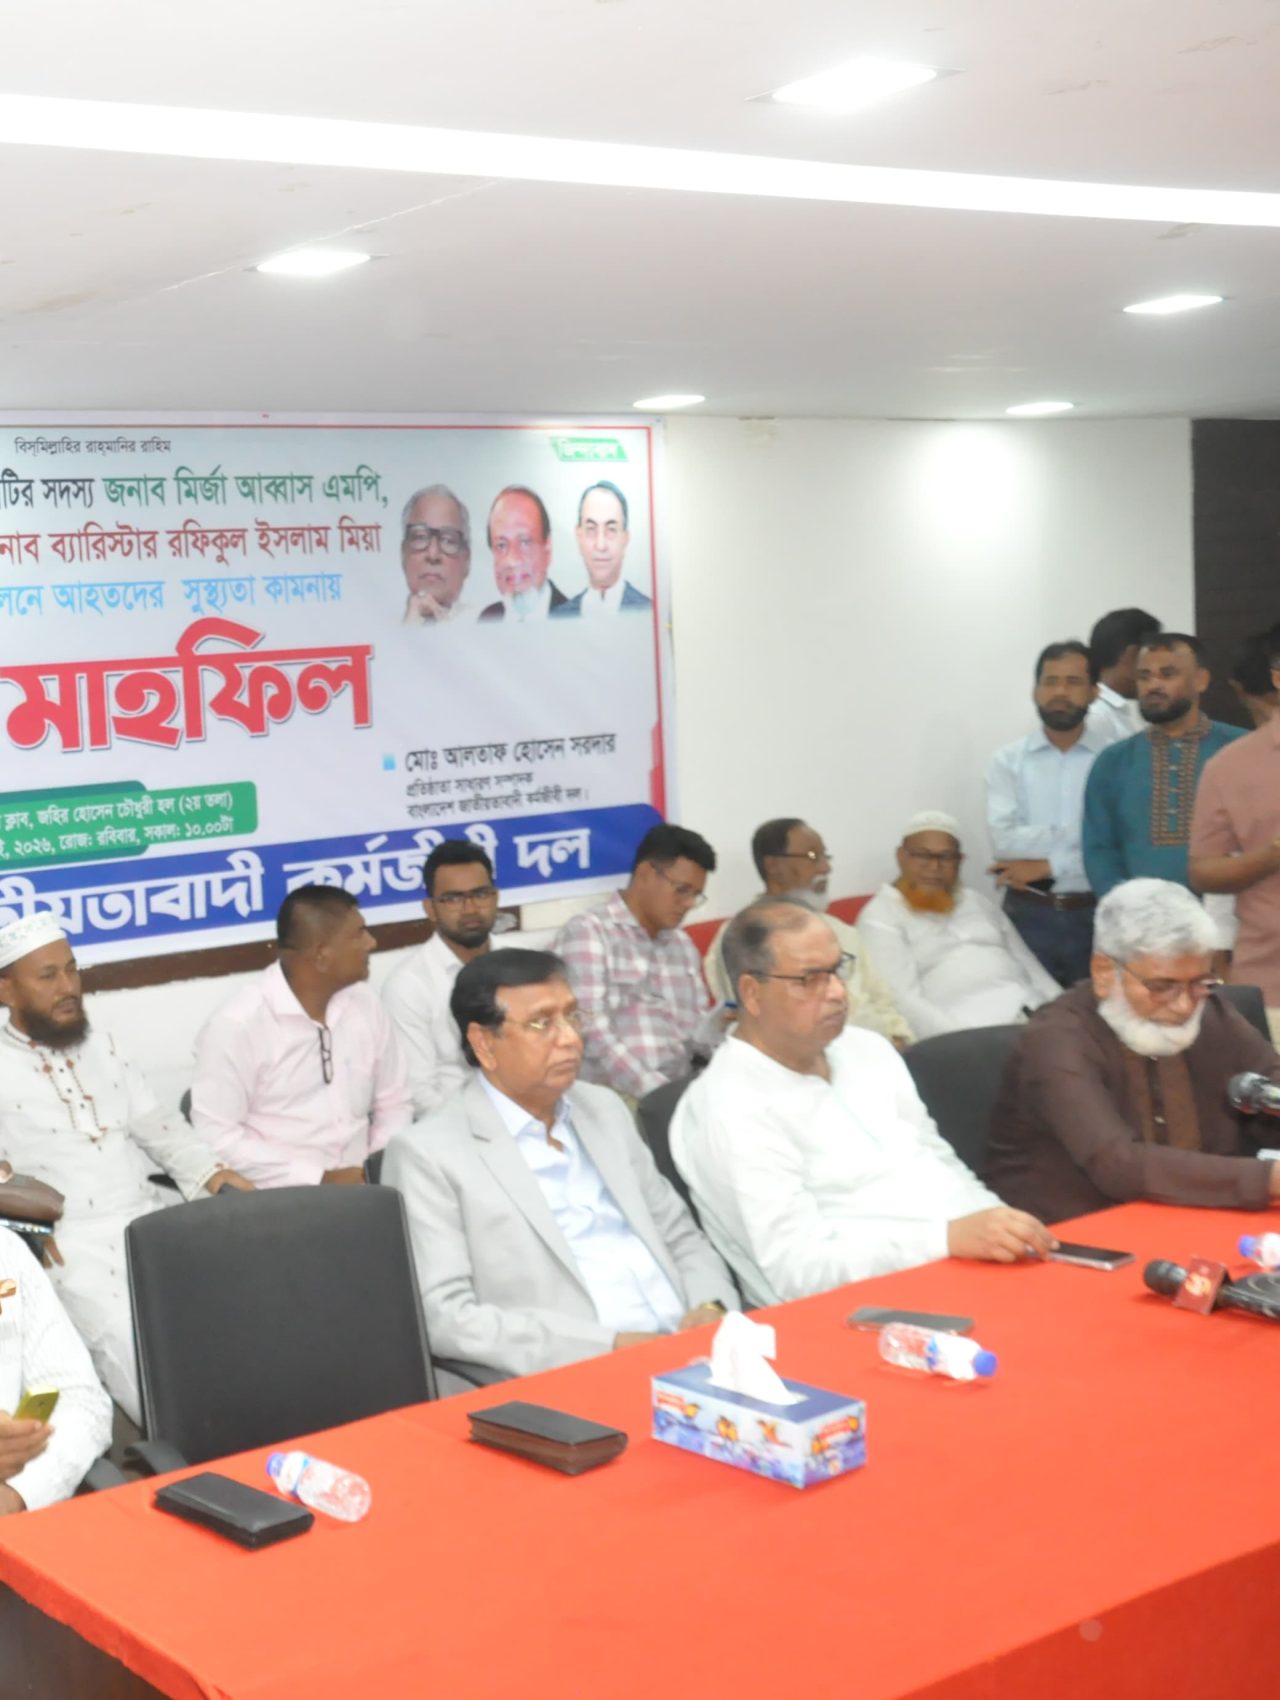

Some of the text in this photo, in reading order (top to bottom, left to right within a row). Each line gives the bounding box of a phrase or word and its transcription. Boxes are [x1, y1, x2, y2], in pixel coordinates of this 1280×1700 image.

[140, 436, 171, 453] রাহিম
[40, 477, 95, 508] সদস্য
[102, 474, 167, 507] জনাব
[174, 464, 228, 505] মির্জা
[235, 473, 314, 504] আব্বাস
[323, 464, 388, 508] এমপি,
[48, 521, 159, 564] ব্যারিস্টার
[166, 518, 248, 566] রফিকুল
[255, 517, 331, 558] ইসলাম
[338, 515, 382, 553] মিয়া
[51, 580, 165, 616] আহতদের
[262, 571, 342, 604] কামনায়
[405, 733, 616, 772] মোঃ আলতাফ হোসেন সরদার
[37, 804, 69, 826] জহির
[73, 803, 113, 822] হোসেন
[116, 795, 154, 820] চৌধুরী
[157, 798, 175, 815] হল
[513, 827, 592, 877] দল
